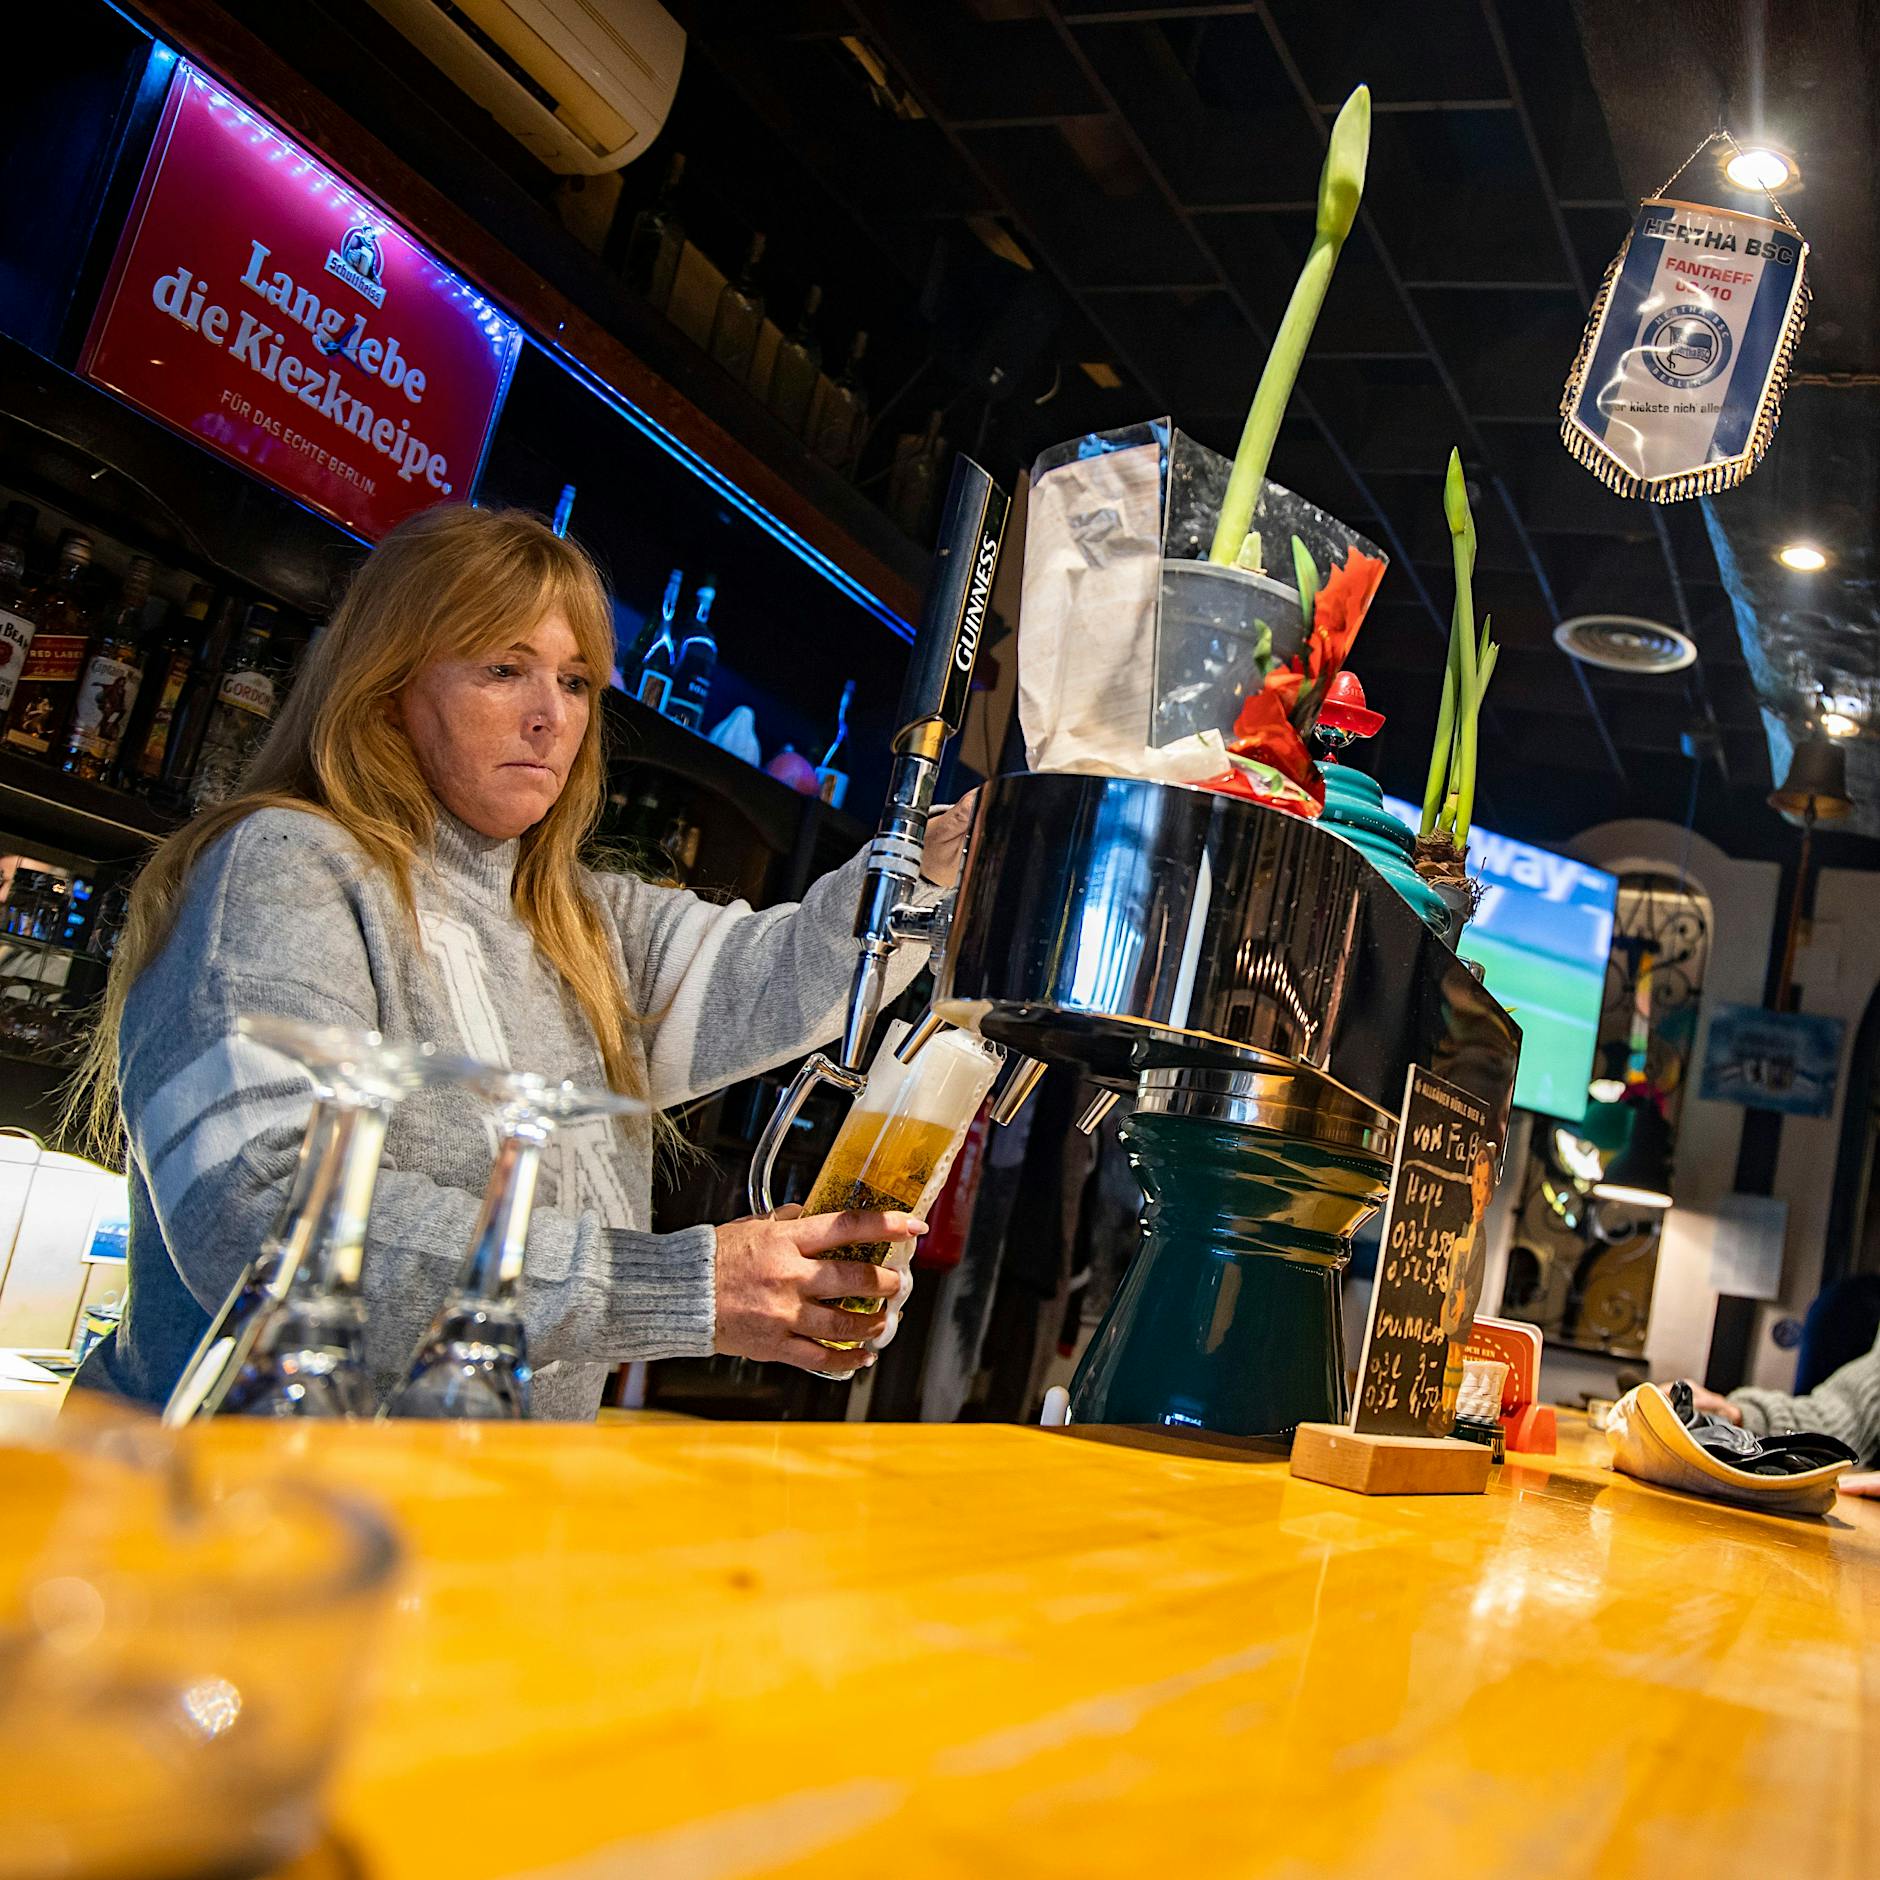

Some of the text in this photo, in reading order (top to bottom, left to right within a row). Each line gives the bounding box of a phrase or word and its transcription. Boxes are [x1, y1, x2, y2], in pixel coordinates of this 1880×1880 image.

[1642, 217, 1793, 266] HERTHA BSC
[1665, 255, 1754, 286] FANTREFF
[329, 256, 381, 302] Schultheiss
[240, 239, 426, 404] Lang lebe
[152, 266, 453, 495] die Kiezkneipe.
[220, 389, 251, 419] FÜR
[253, 409, 281, 438] DAS
[284, 427, 329, 466] ECHTE
[955, 533, 998, 673] GUINNESS
[30, 650, 51, 658] RED
